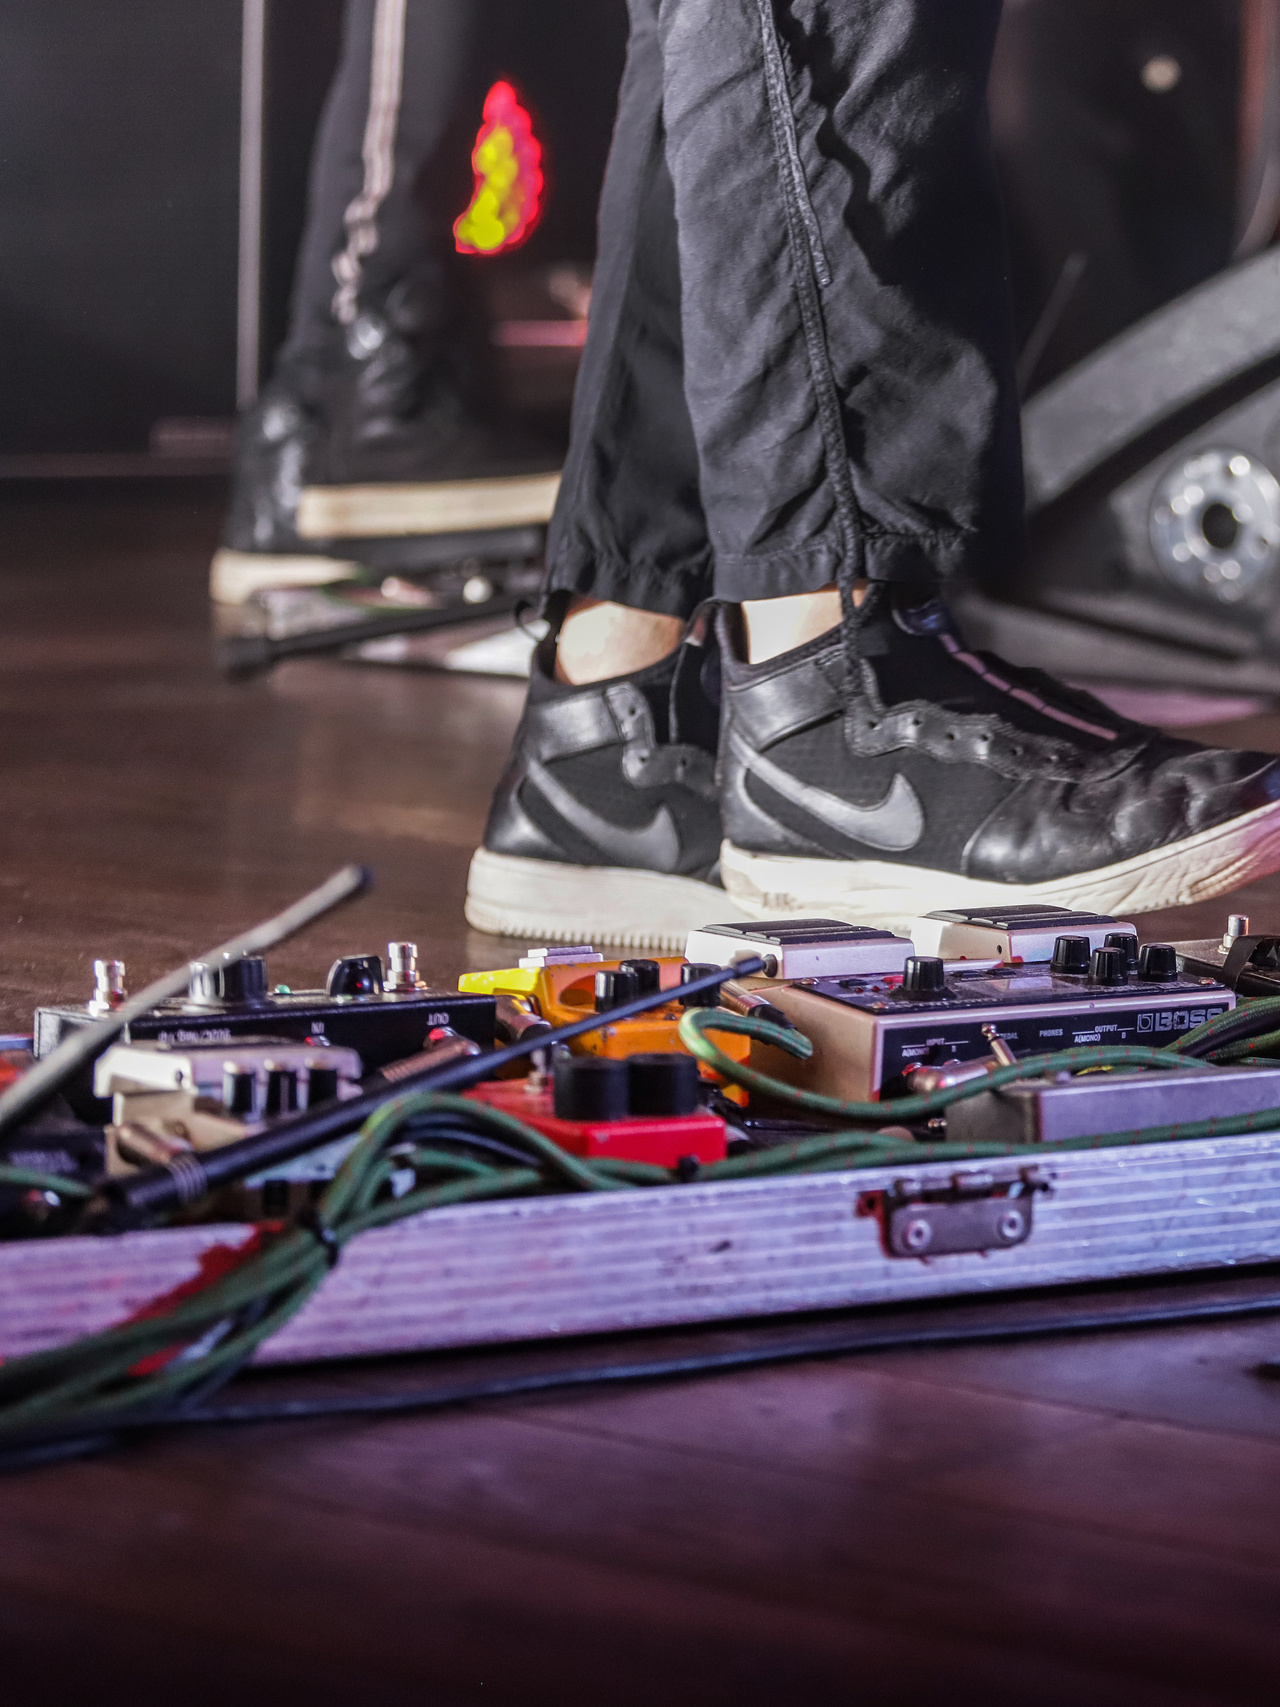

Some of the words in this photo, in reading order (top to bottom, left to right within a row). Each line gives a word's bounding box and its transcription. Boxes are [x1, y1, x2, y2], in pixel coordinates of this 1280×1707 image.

[427, 1012, 450, 1026] OUT
[310, 1021, 325, 1035] IN
[1039, 1028, 1063, 1038] PHONES
[1094, 1024, 1118, 1033] OUTPUT
[1074, 1033, 1101, 1043] A(MONO)
